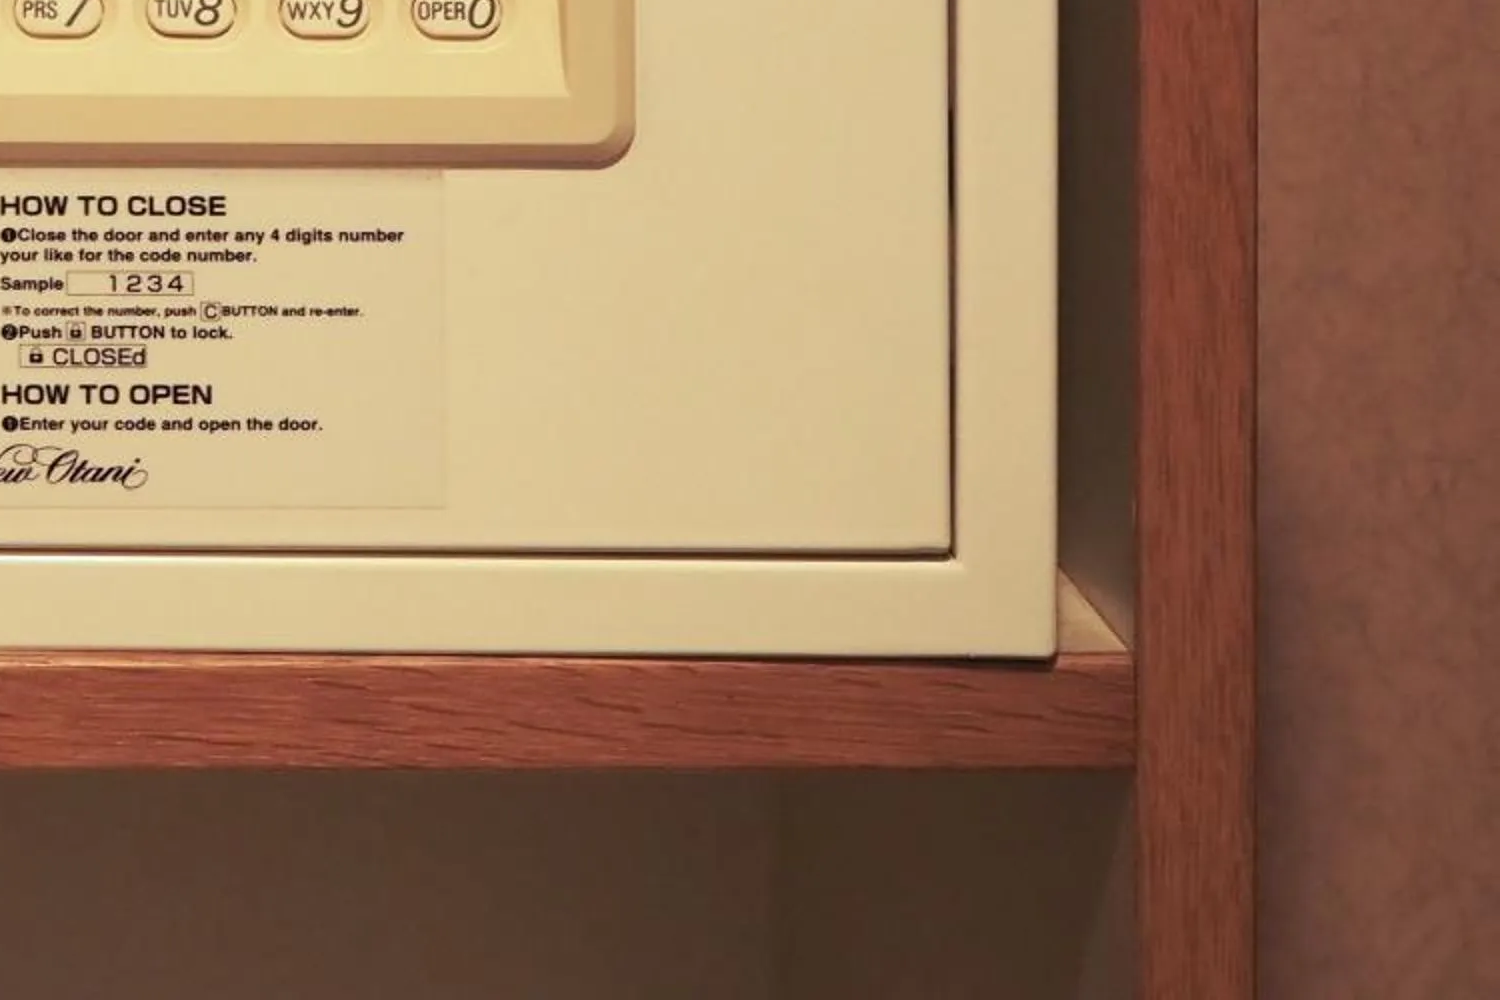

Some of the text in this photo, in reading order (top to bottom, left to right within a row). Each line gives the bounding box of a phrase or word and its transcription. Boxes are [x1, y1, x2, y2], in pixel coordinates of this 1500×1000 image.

[0, 195, 226, 217] HOW TO CLOSE
[72, 228, 98, 243] the
[104, 228, 142, 243] door
[148, 228, 180, 243] and
[186, 230, 229, 243] enter
[235, 232, 264, 247] any
[271, 229, 280, 242] 4
[286, 228, 332, 247] digits
[339, 229, 404, 243] number
[0, 248, 257, 267] your like for the code number.
[1, 276, 63, 293] Sample
[33, 306, 79, 318] correct
[84, 306, 104, 318] the
[164, 307, 196, 320] push
[222, 306, 277, 318] BUTTON
[282, 306, 304, 318] and
[91, 325, 165, 340] BUTTON
[171, 326, 187, 340] to
[193, 325, 232, 340] lock.
[53, 348, 146, 366] CLOSEd
[1, 384, 212, 405] HOW TO OPEN
[71, 420, 108, 435] your
[115, 417, 156, 432] code
[162, 417, 193, 432] and
[199, 420, 240, 436] open
[247, 417, 272, 432] the
[278, 417, 323, 432] door.
[36, 446, 148, 489] Otani
